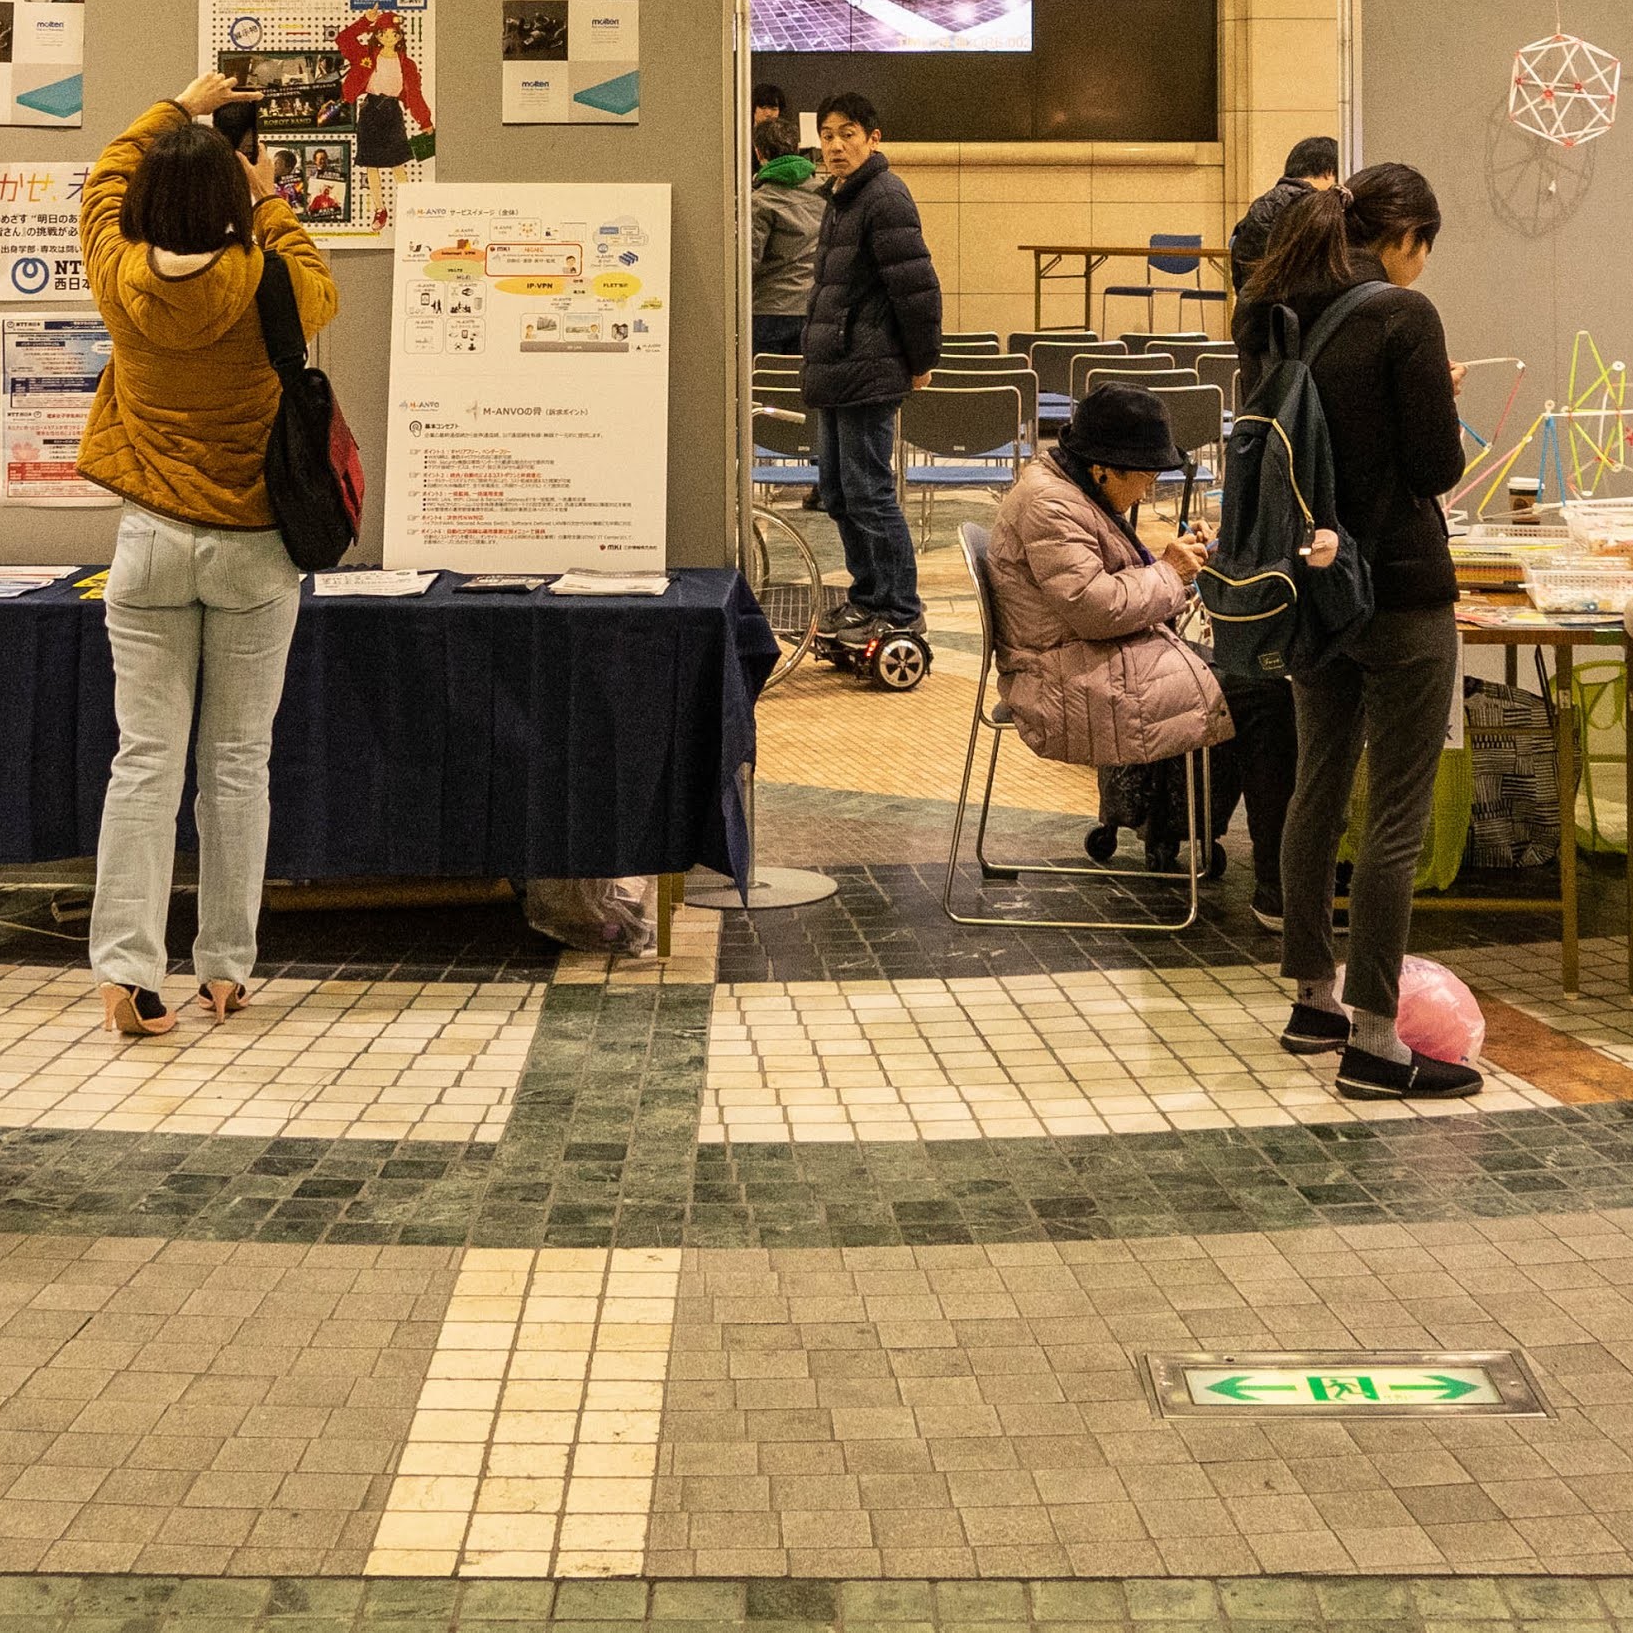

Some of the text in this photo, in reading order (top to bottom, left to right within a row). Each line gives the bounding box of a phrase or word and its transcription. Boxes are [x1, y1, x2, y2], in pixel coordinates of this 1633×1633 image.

[31, 214, 80, 224] “明日のあ
[54, 261, 85, 275] NT
[54, 278, 90, 290] 西日本
